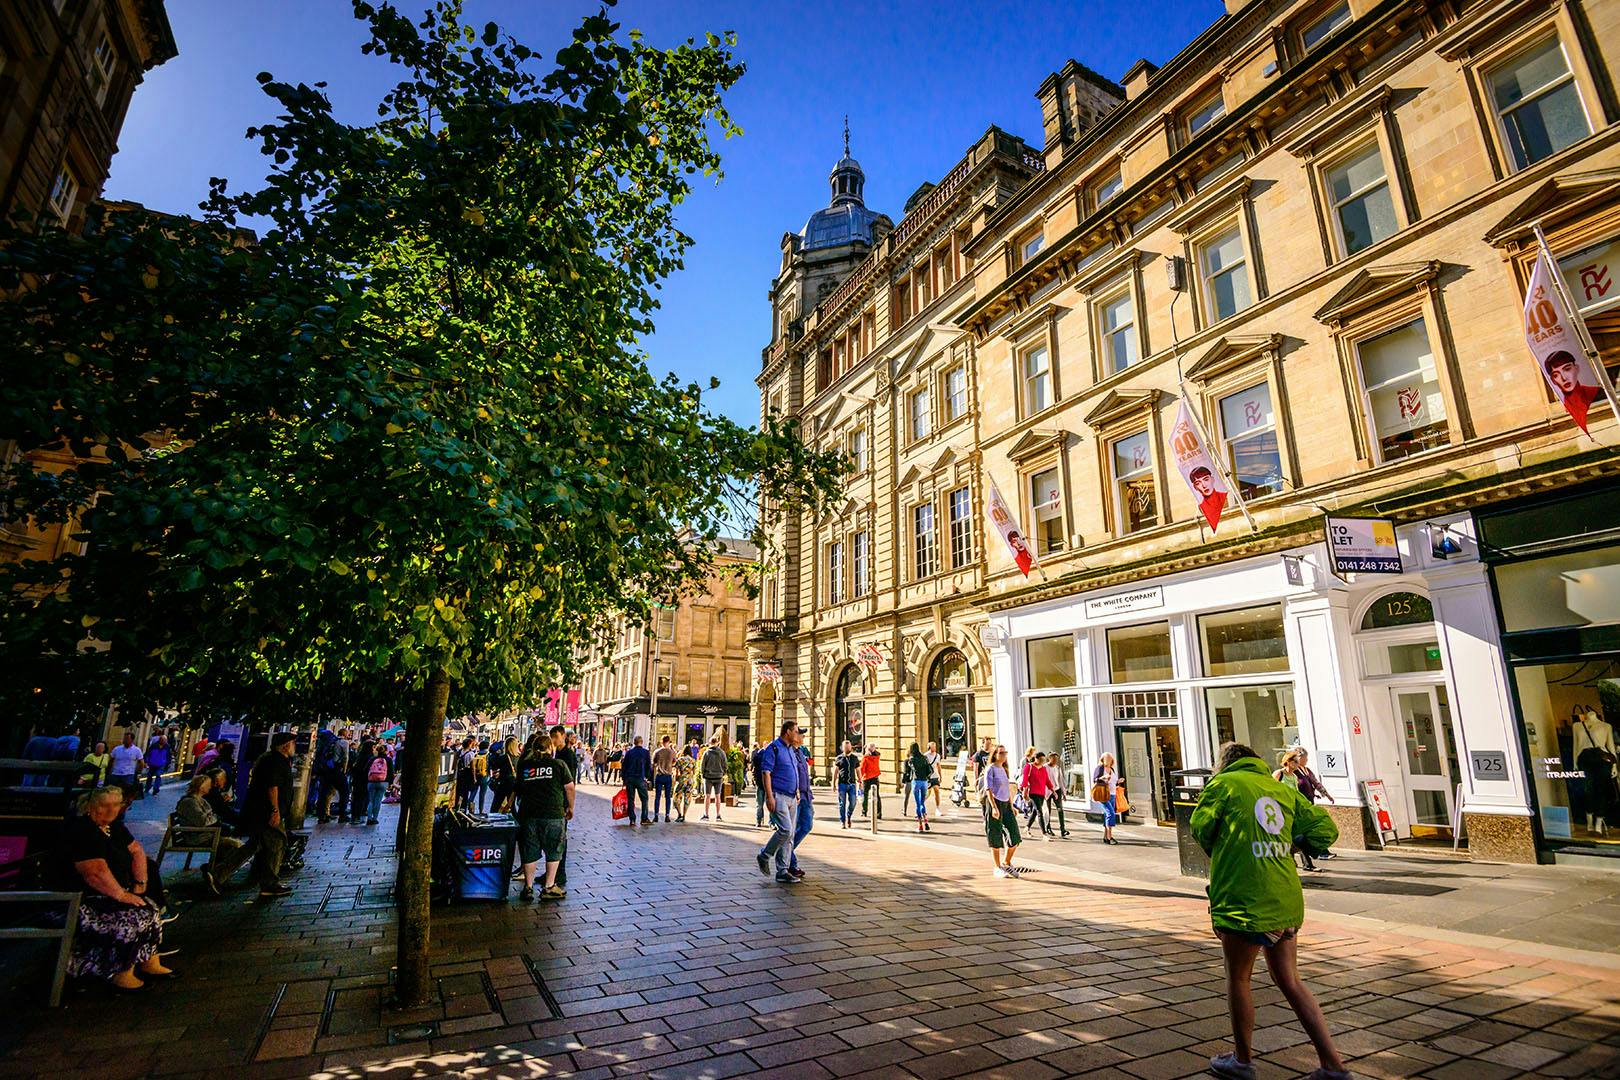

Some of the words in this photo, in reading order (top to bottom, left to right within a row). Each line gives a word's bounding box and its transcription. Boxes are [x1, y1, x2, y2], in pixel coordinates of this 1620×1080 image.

[1527, 300, 1558, 334] 40
[1532, 324, 1563, 343] EARS
[1174, 431, 1199, 455] 40
[1331, 526, 1348, 535] TO
[1333, 536, 1353, 545] LET
[1337, 561, 1358, 570] 0141
[1359, 561, 1377, 570] 248
[1378, 561, 1400, 571] 7342
[1103, 597, 1123, 606] WHITE
[1124, 591, 1157, 603] COMPANY
[1388, 600, 1411, 616] 125
[1474, 758, 1503, 771] 125
[536, 766, 553, 777] IPG
[482, 848, 502, 860] IPG
